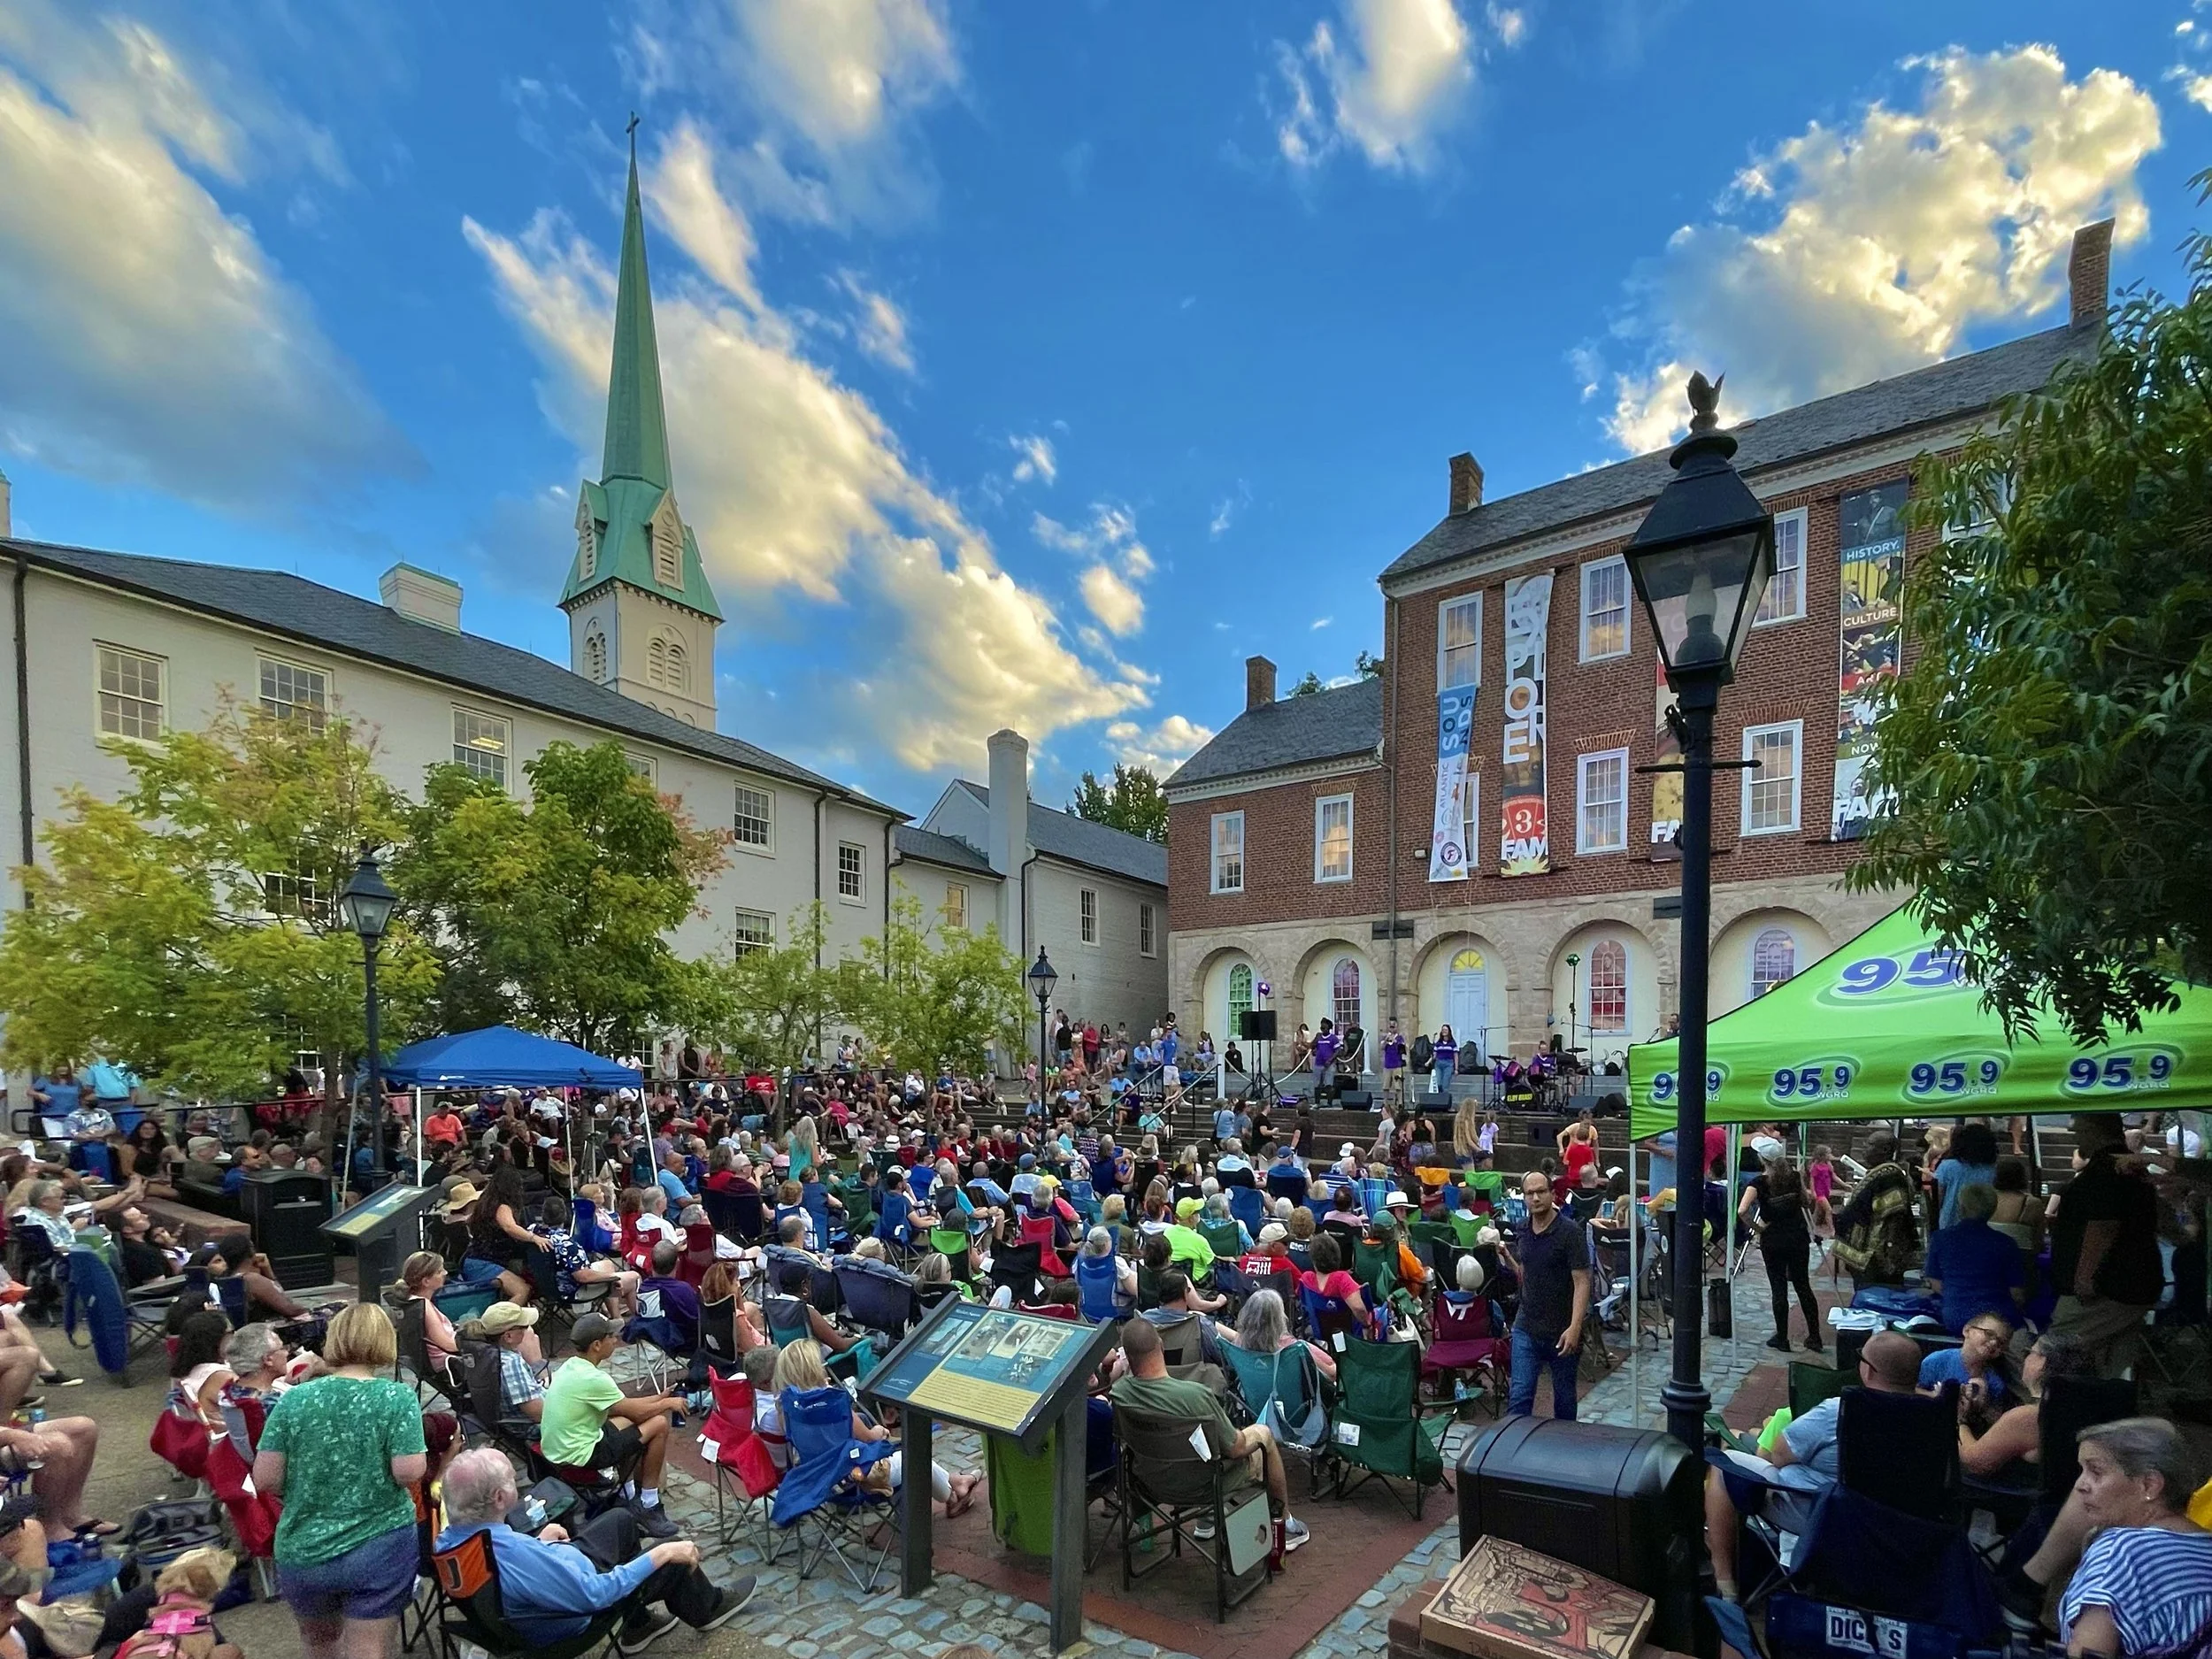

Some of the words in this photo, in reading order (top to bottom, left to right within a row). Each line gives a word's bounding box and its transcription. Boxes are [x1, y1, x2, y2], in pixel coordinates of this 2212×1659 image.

[1847, 540, 1900, 561] HISTORY.
[1843, 607, 1899, 627] CULTURE.
[1501, 835, 1547, 860] FAM
[1653, 1071, 1721, 1099] 99
[1773, 1065, 1851, 1096] 95.9
[1909, 1060, 2000, 1094] 95.9
[2068, 1054, 2171, 1088] 95.9
